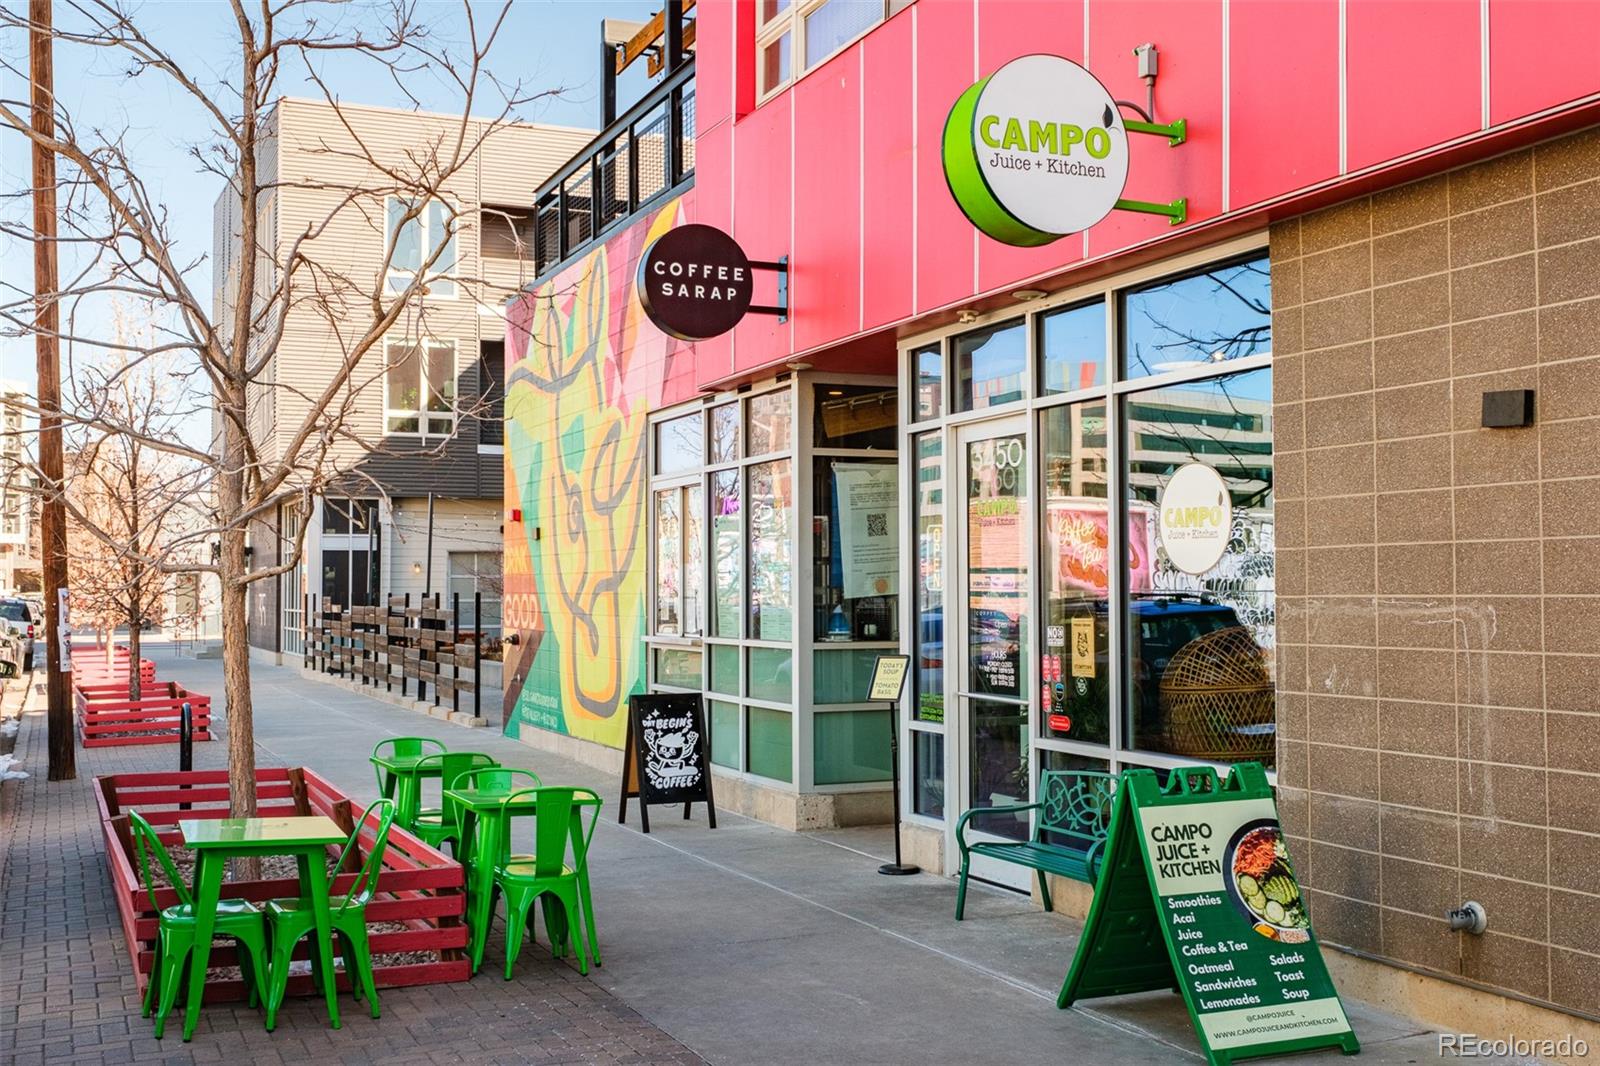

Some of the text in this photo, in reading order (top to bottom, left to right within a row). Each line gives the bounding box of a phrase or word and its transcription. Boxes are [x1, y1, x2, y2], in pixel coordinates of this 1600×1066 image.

[980, 115, 1112, 160] CAMPO
[990, 153, 1106, 179] Juice + Kitchen
[654, 261, 744, 281] COFFEE
[662, 282, 737, 301] SARAP
[971, 438, 1023, 471] 3450
[1164, 506, 1223, 529] CAMPO
[1059, 519, 1096, 546] Coffee
[932, 527, 943, 590] OPEN
[504, 593, 538, 630] GOOD
[655, 717, 693, 730] BEGINS
[655, 775, 694, 790] COFFEE
[1151, 822, 1213, 843] CAMPO
[1156, 842, 1211, 862] JUICE +
[1159, 859, 1222, 879] KITCHEN
[1167, 894, 1222, 910] Smoothies
[1172, 911, 1196, 925] Acai
[1177, 929, 1204, 941] Juice
[1182, 940, 1249, 957] Coffee & Tea
[1188, 959, 1235, 976] Oatmeal
[1268, 952, 1305, 967] Salads
[1194, 976, 1258, 993] Sandwiches
[1273, 969, 1306, 983] Toast
[1199, 993, 1261, 1010] Lemonades
[1282, 988, 1310, 1000] Soup
[1246, 1009, 1296, 1023] @CAMPOJUICE
[1212, 1016, 1339, 1040] WWW.CAMPOJUICEANDKITCHEN.COM
